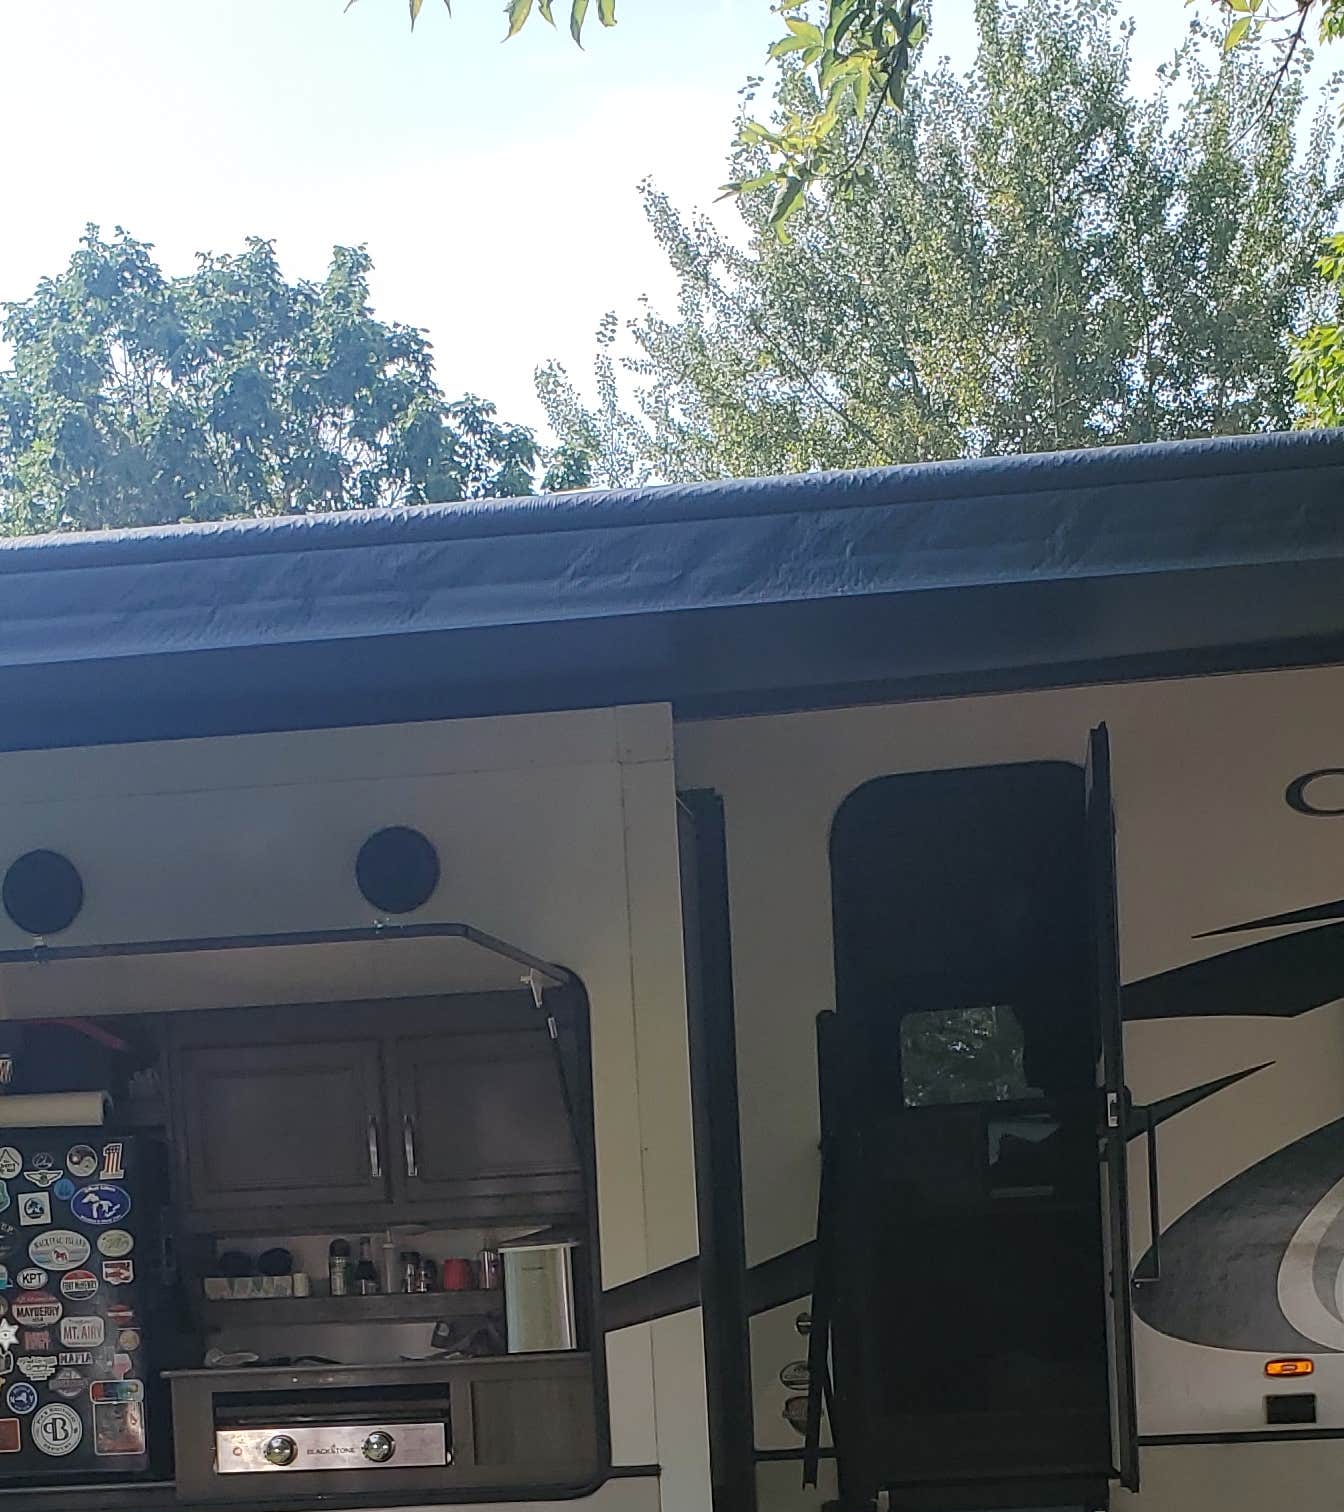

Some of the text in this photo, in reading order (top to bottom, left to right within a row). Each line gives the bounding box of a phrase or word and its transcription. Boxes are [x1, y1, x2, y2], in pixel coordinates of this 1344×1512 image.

[22, 1273, 42, 1284] KPT
[17, 1306, 59, 1317] MAYBERRY
[63, 1326, 80, 1340] MT.
[60, 1353, 92, 1364] MAFIA
